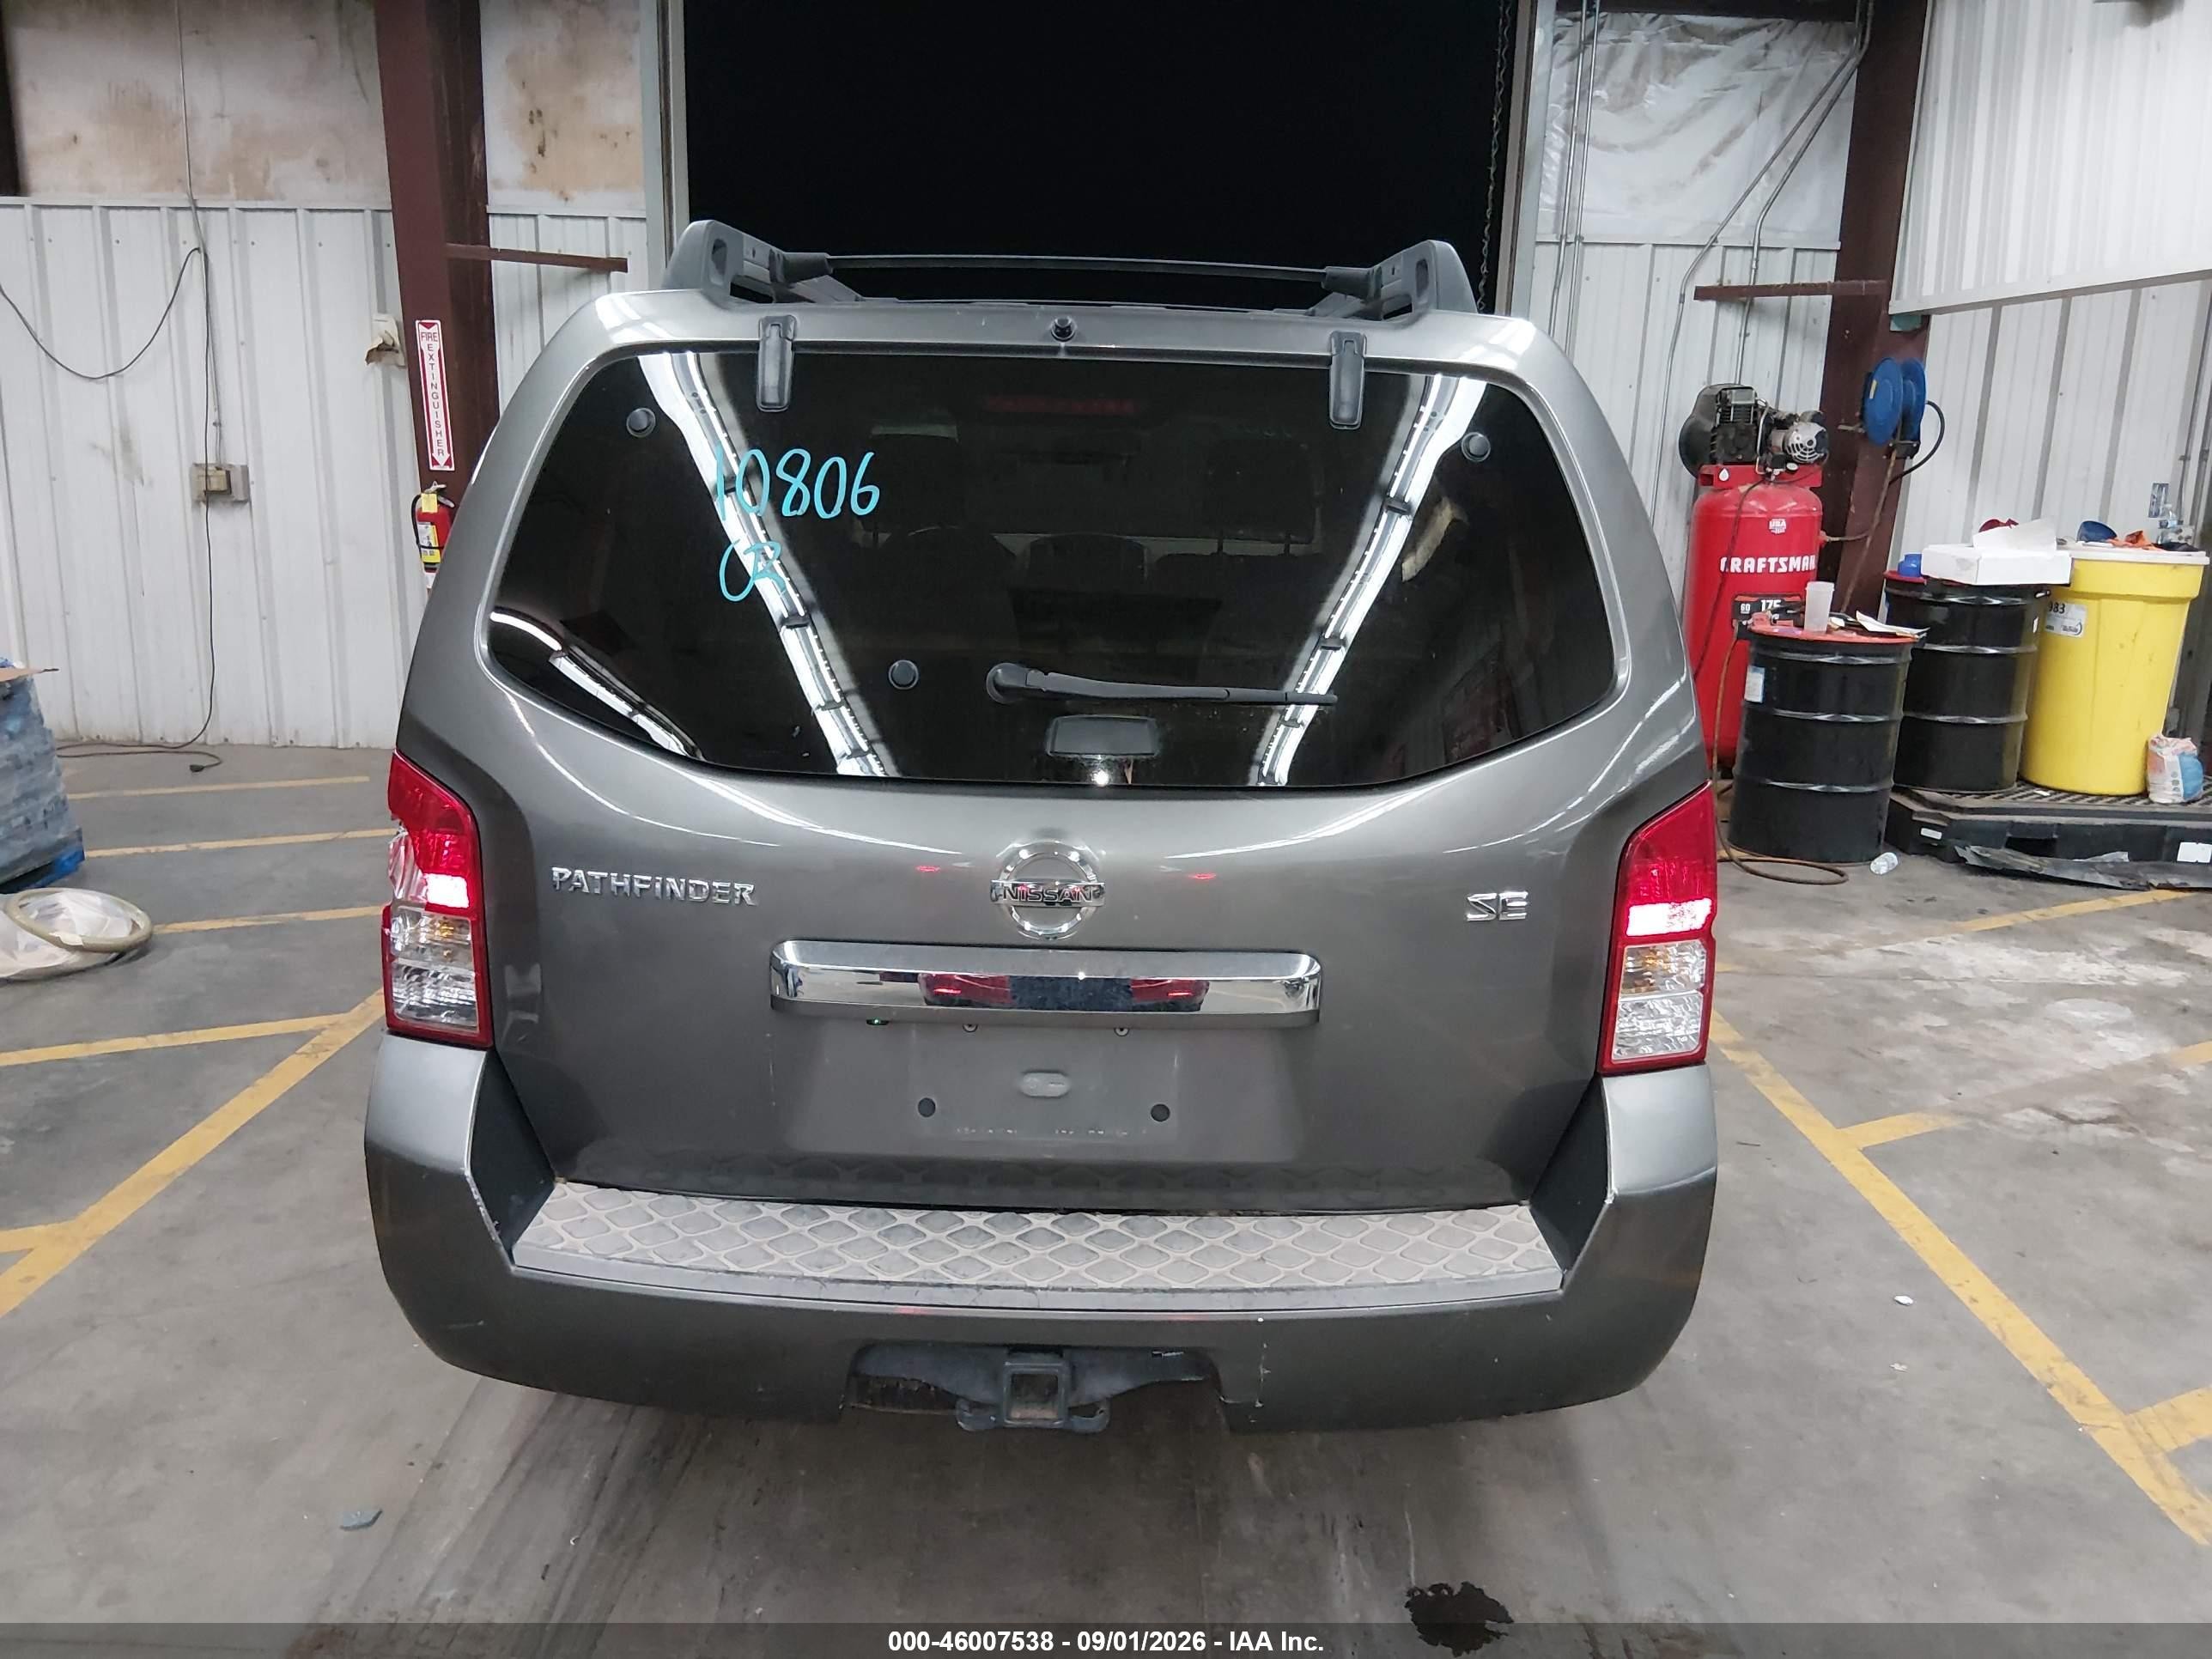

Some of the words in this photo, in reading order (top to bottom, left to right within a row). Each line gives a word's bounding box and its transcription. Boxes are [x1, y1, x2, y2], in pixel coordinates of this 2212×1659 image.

[420, 331, 439, 343] FIRE
[427, 343, 445, 457] EXTINGUISHER
[715, 441, 881, 521] 10806
[1720, 556, 1815, 574] CRAFTSMAN
[551, 866, 758, 907] PATHFINDER
[1002, 884, 1094, 903] NISSAN
[1466, 890, 1529, 921] SE
